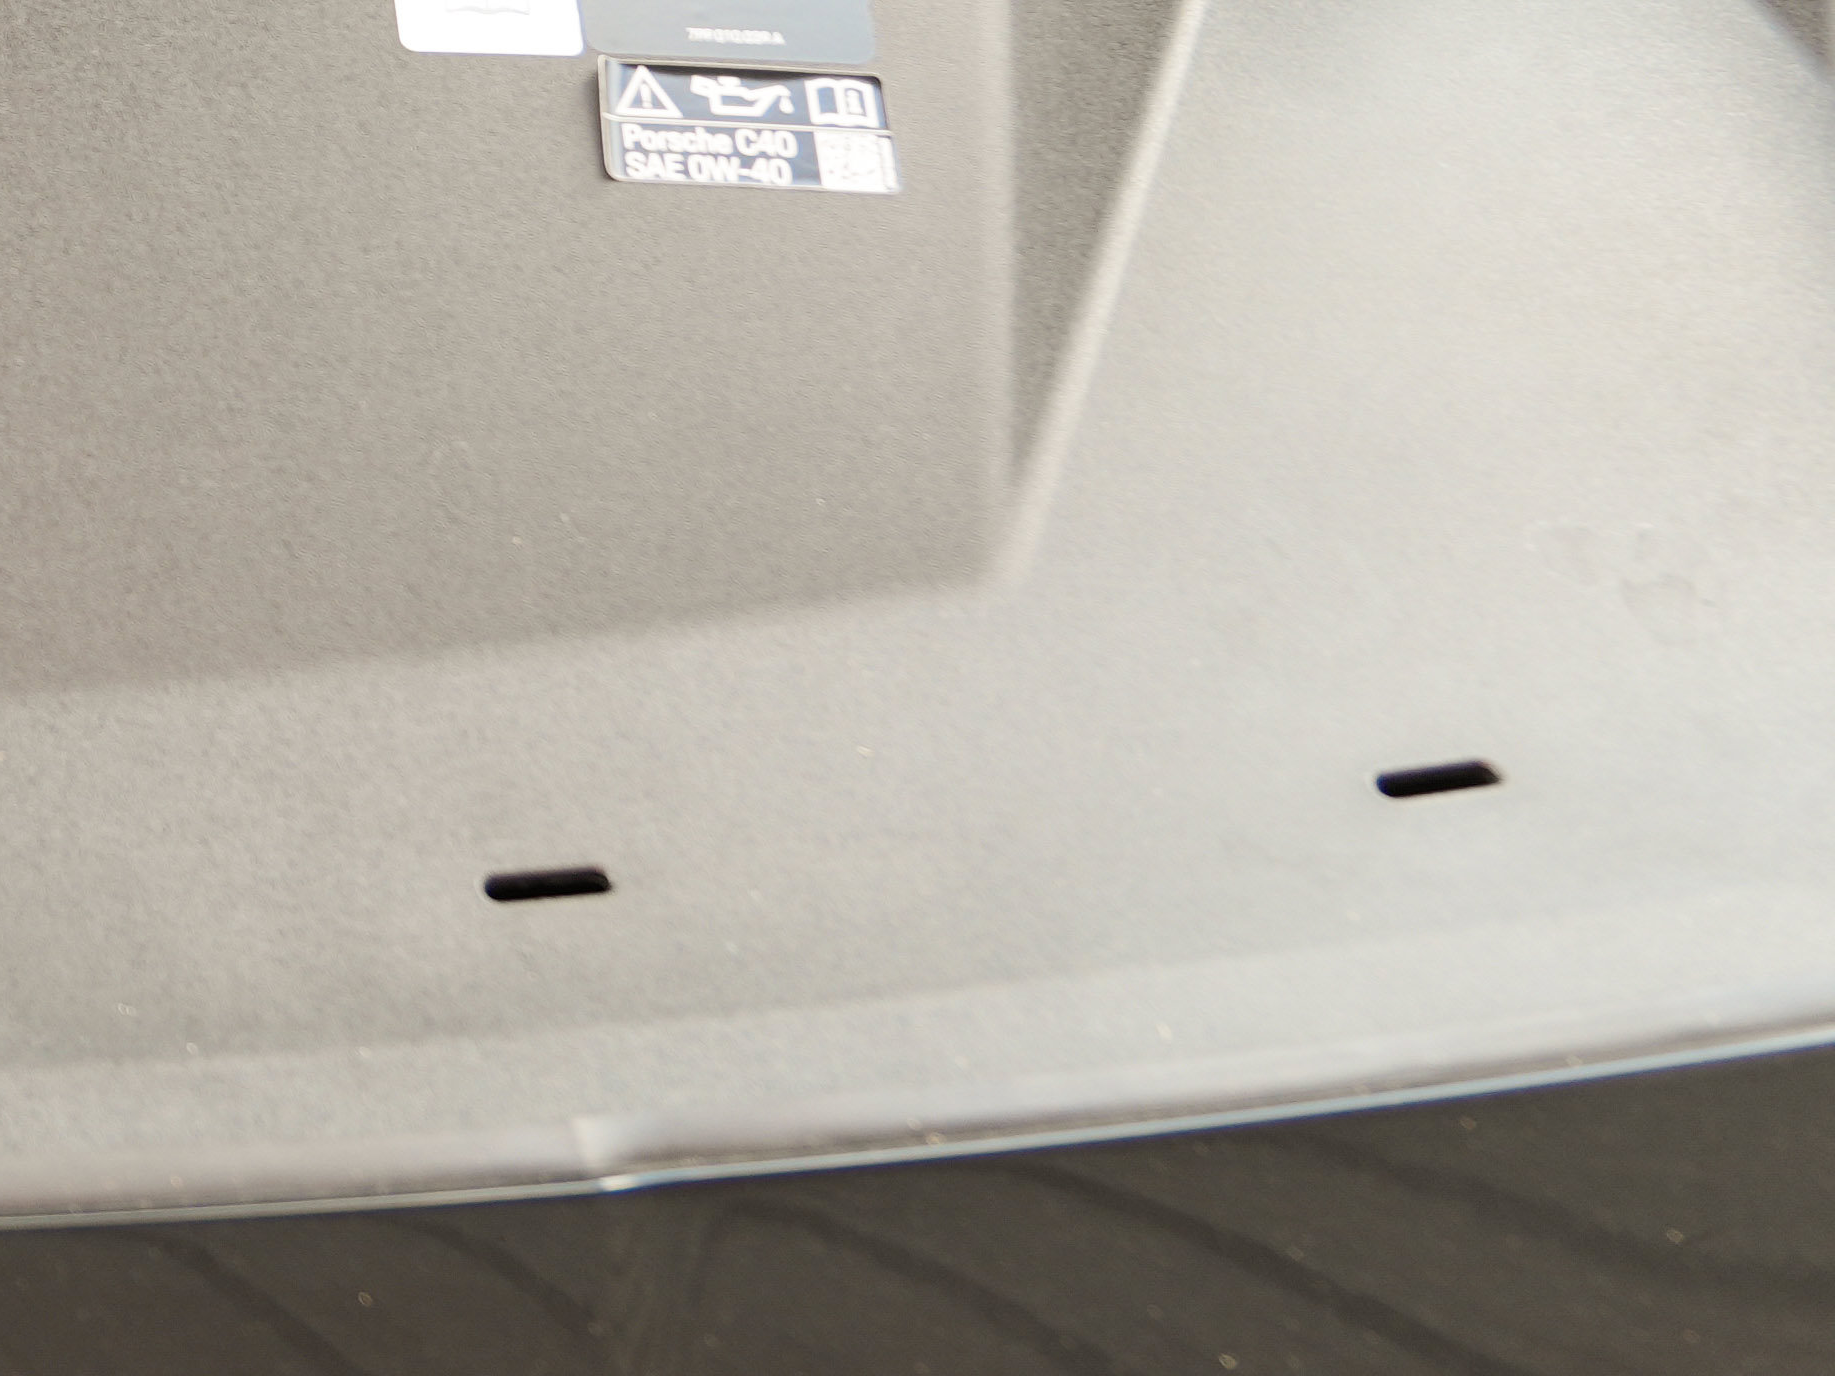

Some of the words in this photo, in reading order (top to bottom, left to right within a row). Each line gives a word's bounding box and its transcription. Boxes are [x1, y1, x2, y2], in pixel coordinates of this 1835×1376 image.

[621, 122, 734, 155] Porsche
[735, 128, 799, 159] C40
[624, 151, 687, 180] SAE
[687, 153, 795, 186] 0W-40
